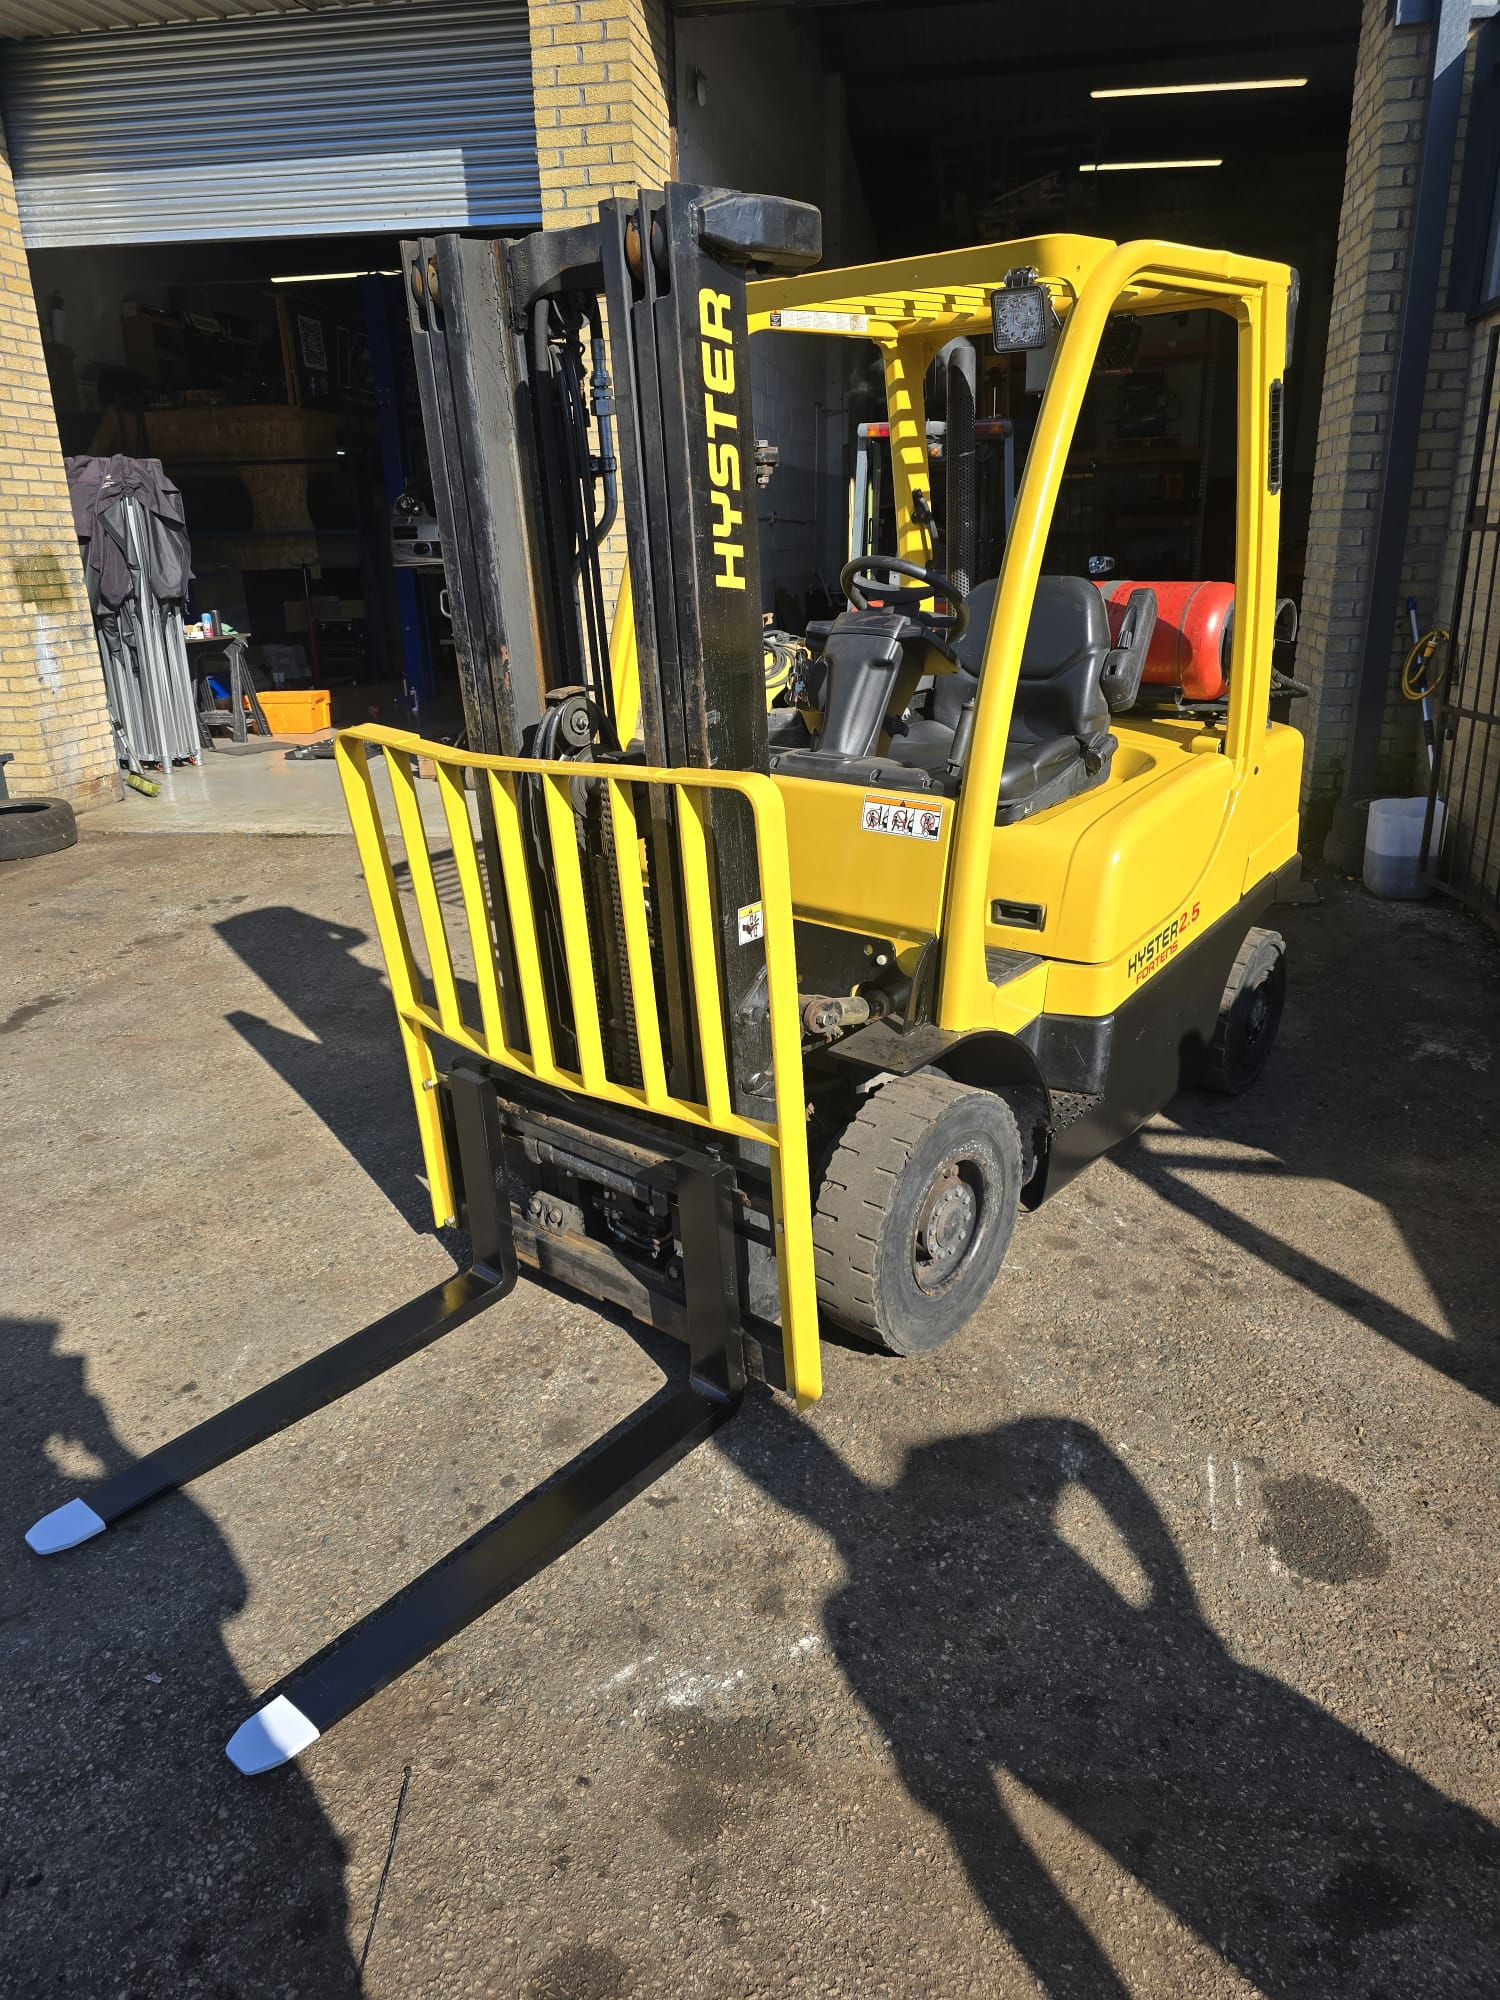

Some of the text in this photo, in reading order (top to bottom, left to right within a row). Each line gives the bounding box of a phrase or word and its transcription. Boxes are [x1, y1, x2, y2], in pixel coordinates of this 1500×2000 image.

[699, 288, 746, 589] HYSTER
[1128, 901, 1200, 978] HYSTER 2.5
[1136, 940, 1178, 984] FORTENS
